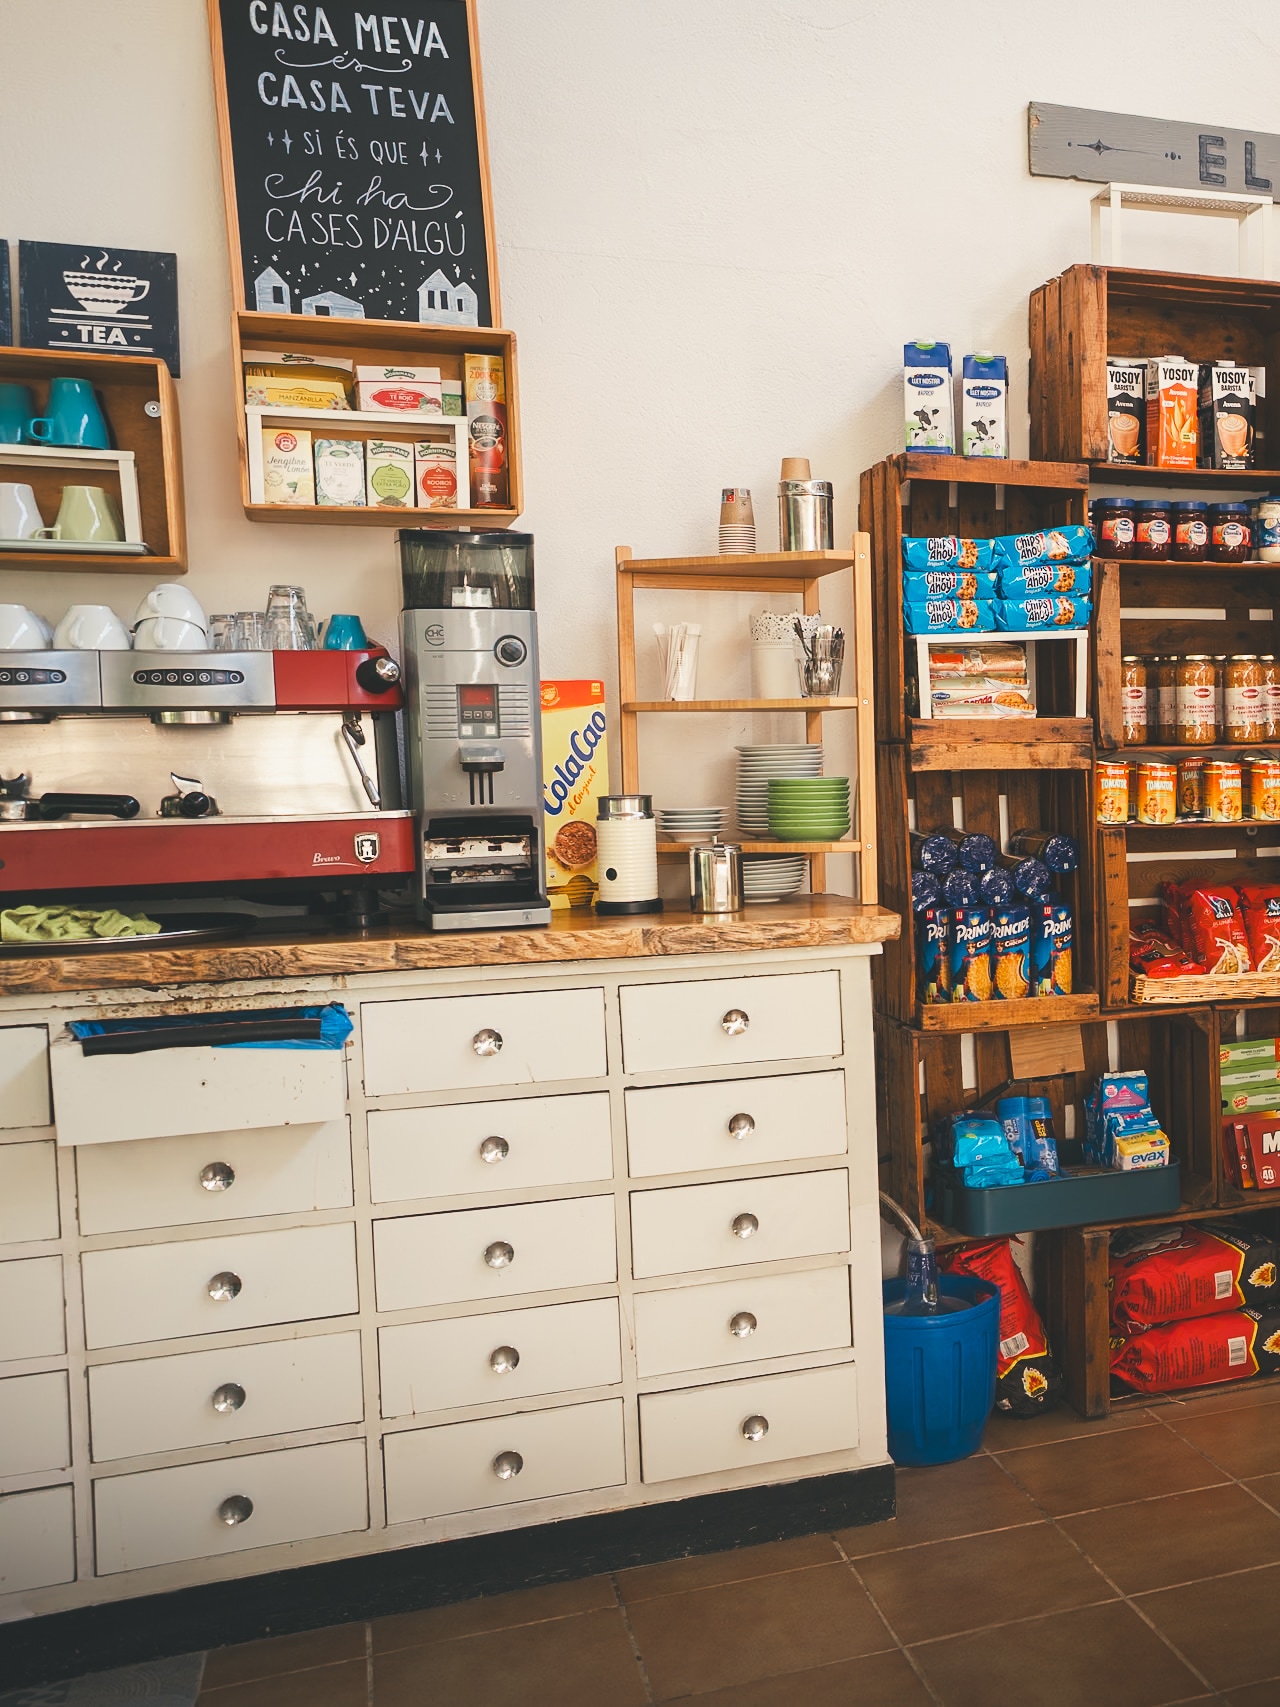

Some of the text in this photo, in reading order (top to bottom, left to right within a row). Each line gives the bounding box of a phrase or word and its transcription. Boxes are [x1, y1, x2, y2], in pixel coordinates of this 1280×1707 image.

[249, 0, 449, 58] CASA MEVA
[257, 71, 454, 124] CASA TEVA
[336, 130, 359, 160] ÉS
[370, 140, 408, 165] QUE
[1198, 134, 1273, 192] EL
[265, 208, 465, 256] CASES D'ALGÚ
[76, 325, 128, 345] TEA
[1109, 370, 1140, 384] YOSOY
[1162, 367, 1194, 381] YOSOY
[1215, 371, 1247, 384] YOSOY
[278, 394, 323, 403] MANZANILLA
[1168, 388, 1188, 396] Avena
[1115, 400, 1134, 408] Avena
[371, 447, 410, 457] HORNIMANS
[419, 448, 456, 457] HORNIMANS
[267, 456, 306, 466] Jengibre
[928, 539, 952, 552] Chips
[1016, 535, 1040, 550] Chips
[926, 572, 951, 584] Chips
[1023, 566, 1047, 577] Chips
[927, 602, 951, 614] Chips
[1025, 600, 1048, 613] Chips
[543, 710, 606, 816] ColaCao
[1044, 906, 1051, 914] LU
[1131, 1150, 1165, 1164] evax
[1262, 1169, 1275, 1181] 40
